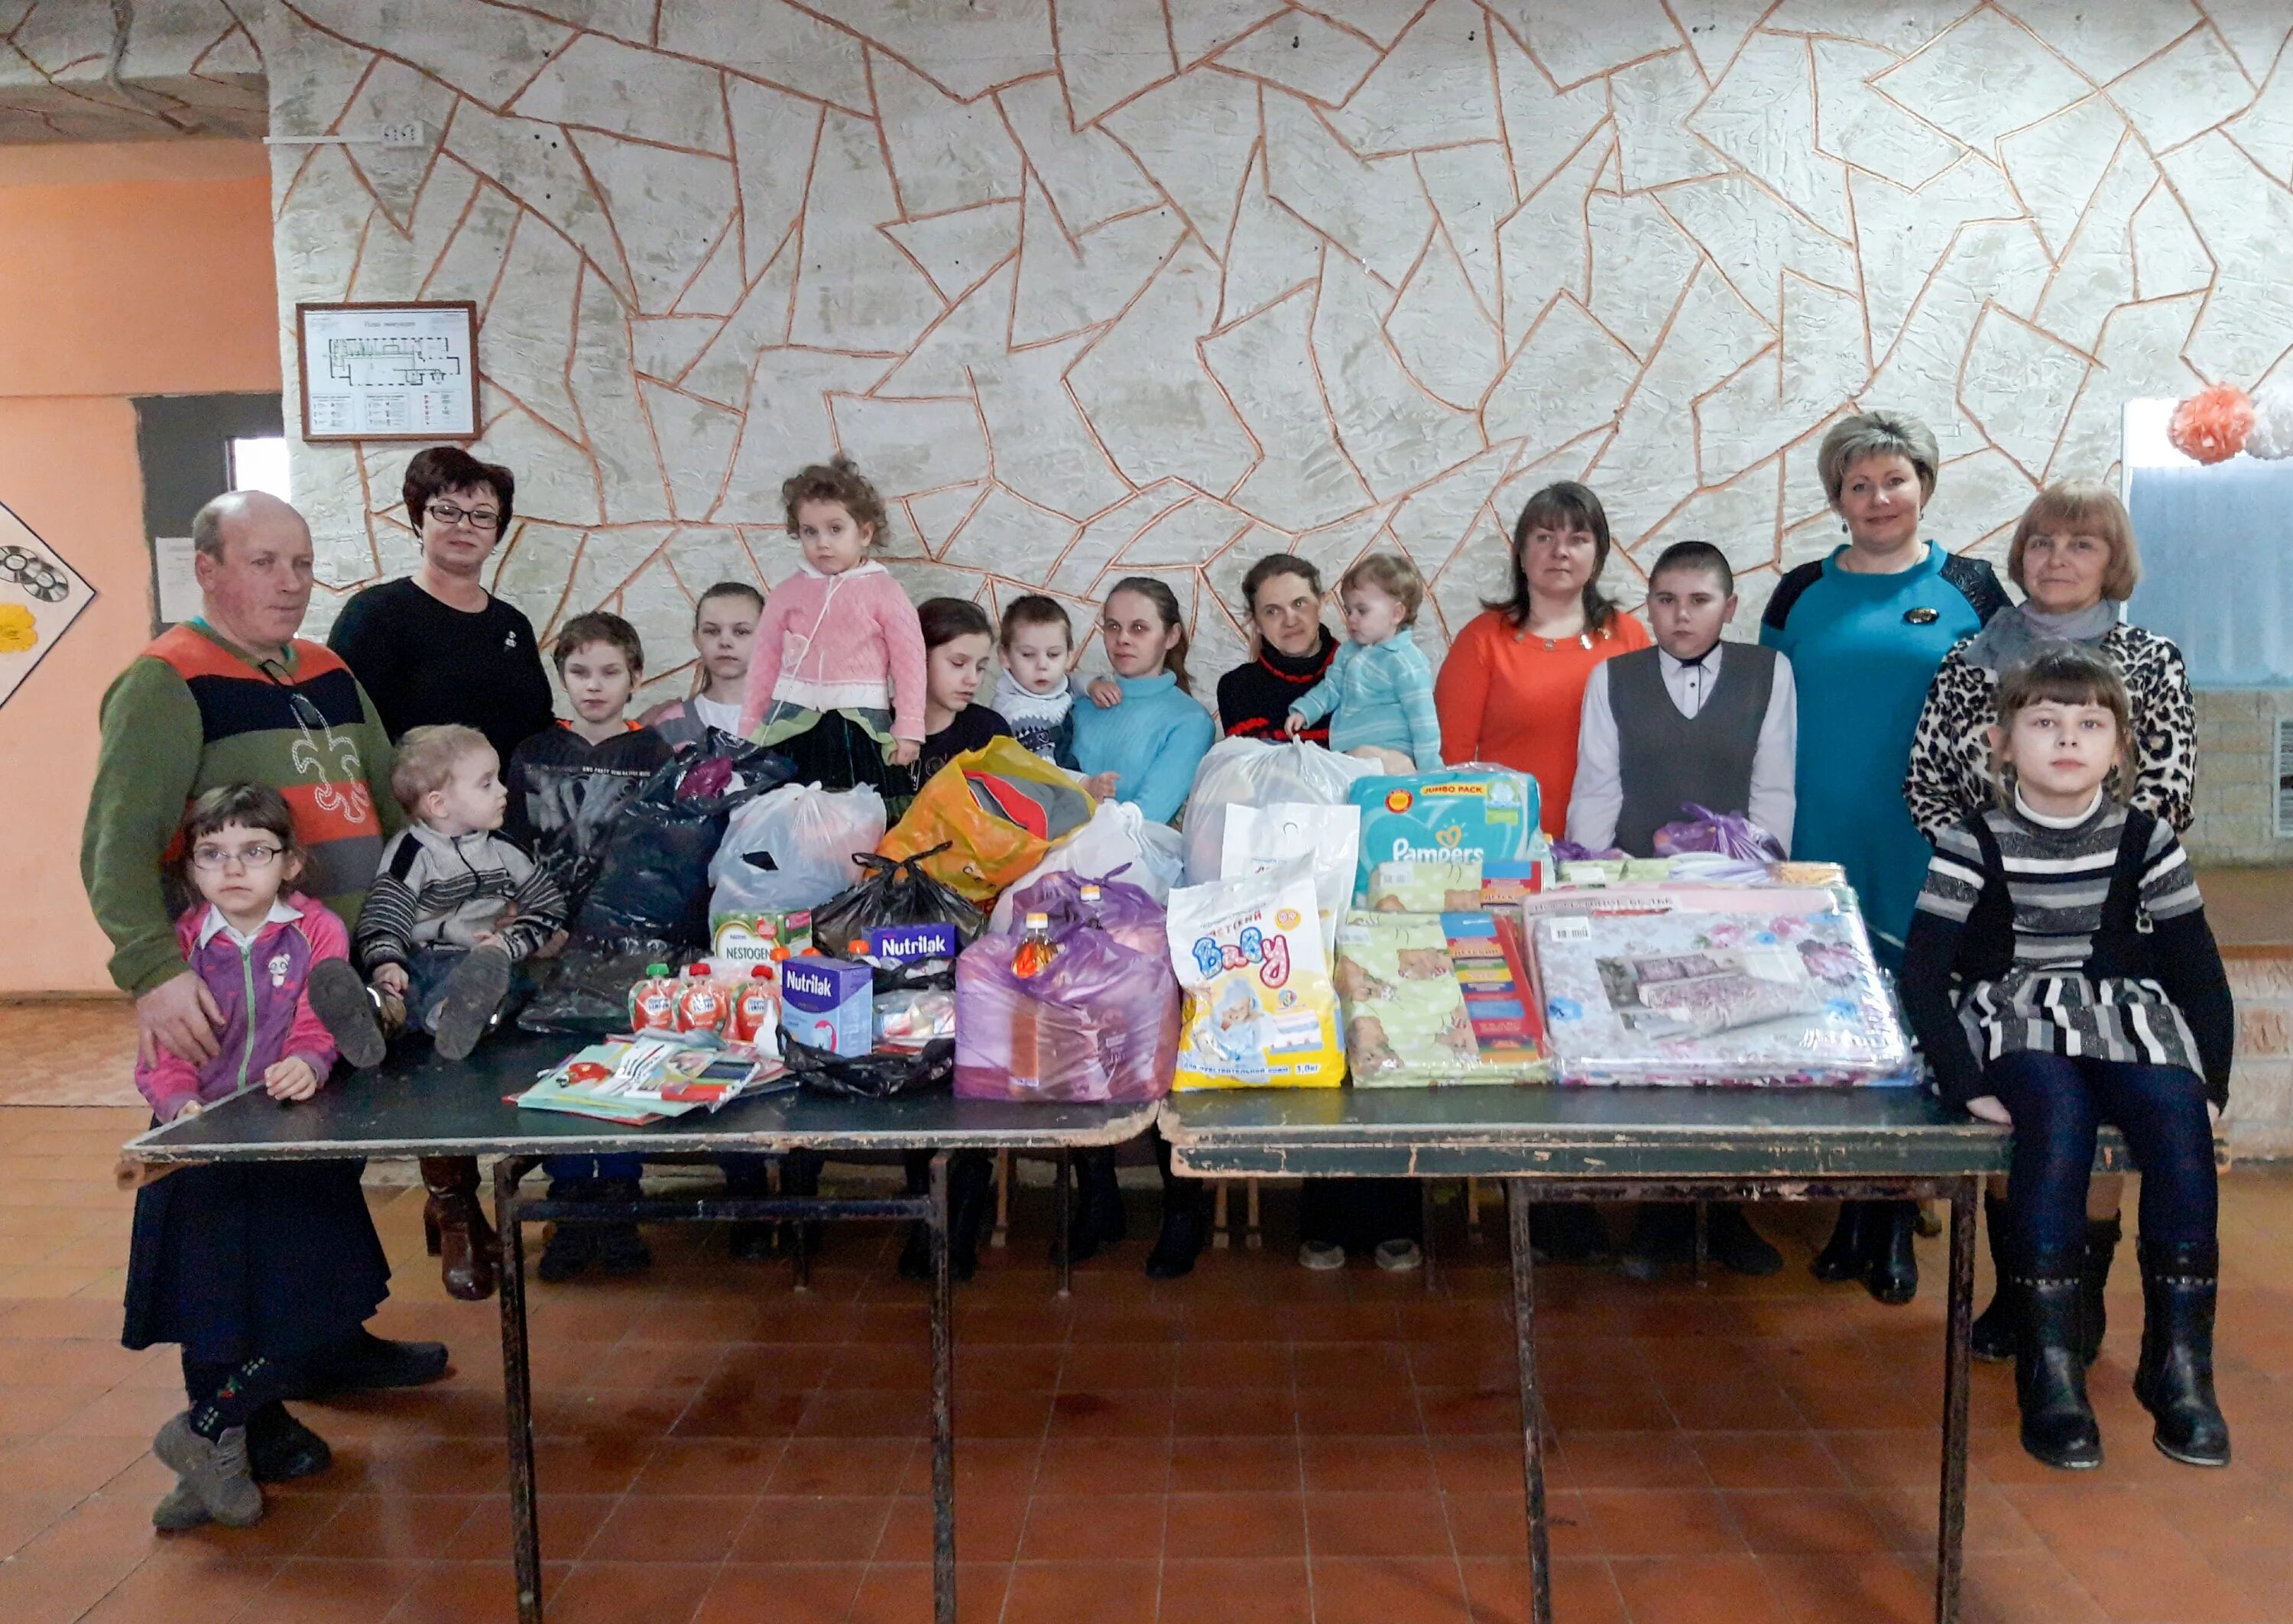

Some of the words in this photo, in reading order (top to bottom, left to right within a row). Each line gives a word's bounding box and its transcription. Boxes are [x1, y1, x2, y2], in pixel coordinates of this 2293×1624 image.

[1424, 786, 1456, 794] JUMBO
[1393, 838, 1484, 864] Pampers
[882, 934, 946, 957] Nutrilak
[786, 969, 832, 997] Nutrilak
